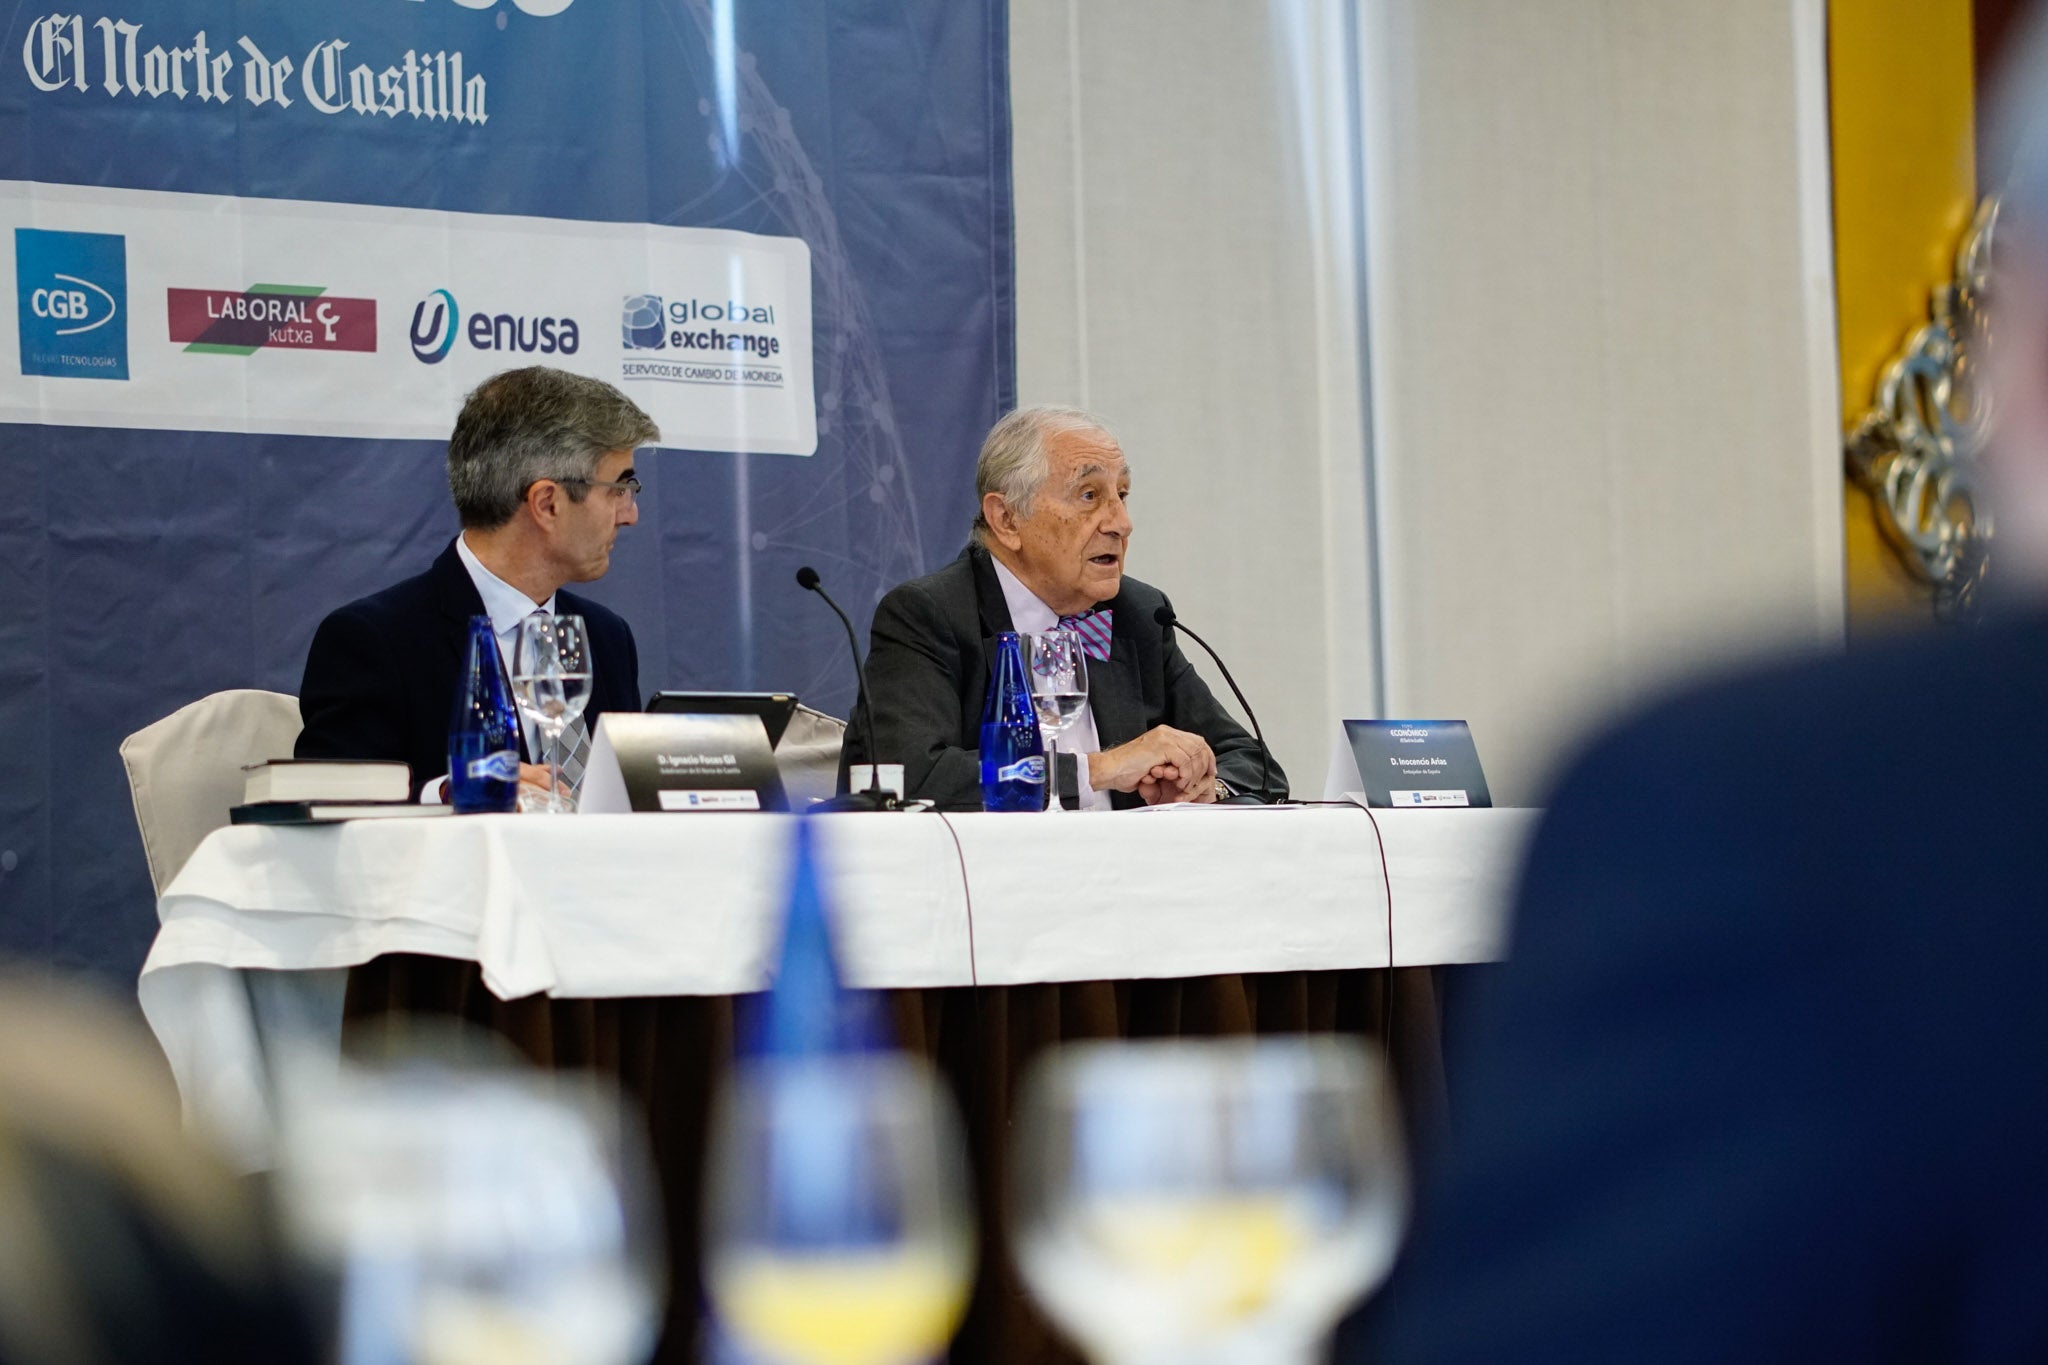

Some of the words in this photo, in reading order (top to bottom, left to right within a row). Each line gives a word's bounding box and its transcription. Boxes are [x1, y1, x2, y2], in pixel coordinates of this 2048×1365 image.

[23, 13, 92, 93] El
[93, 17, 234, 104] Norte
[237, 34, 295, 108] de
[302, 38, 489, 127] Castilla
[32, 288, 88, 320] CGB
[206, 296, 312, 324] LABORAL
[670, 297, 775, 326] global
[268, 326, 314, 345] kutxa
[468, 311, 579, 355] enusa
[671, 326, 779, 358] exchange
[622, 363, 670, 377] SERVICIOS
[672, 366, 682, 378] DE
[684, 367, 722, 380] CAMBIO
[725, 369, 737, 380] DE
[742, 370, 784, 382] MONEDA
[1391, 757, 1399, 766] D.
[1399, 757, 1430, 766] Inocencio
[1430, 757, 1447, 766] Arias
